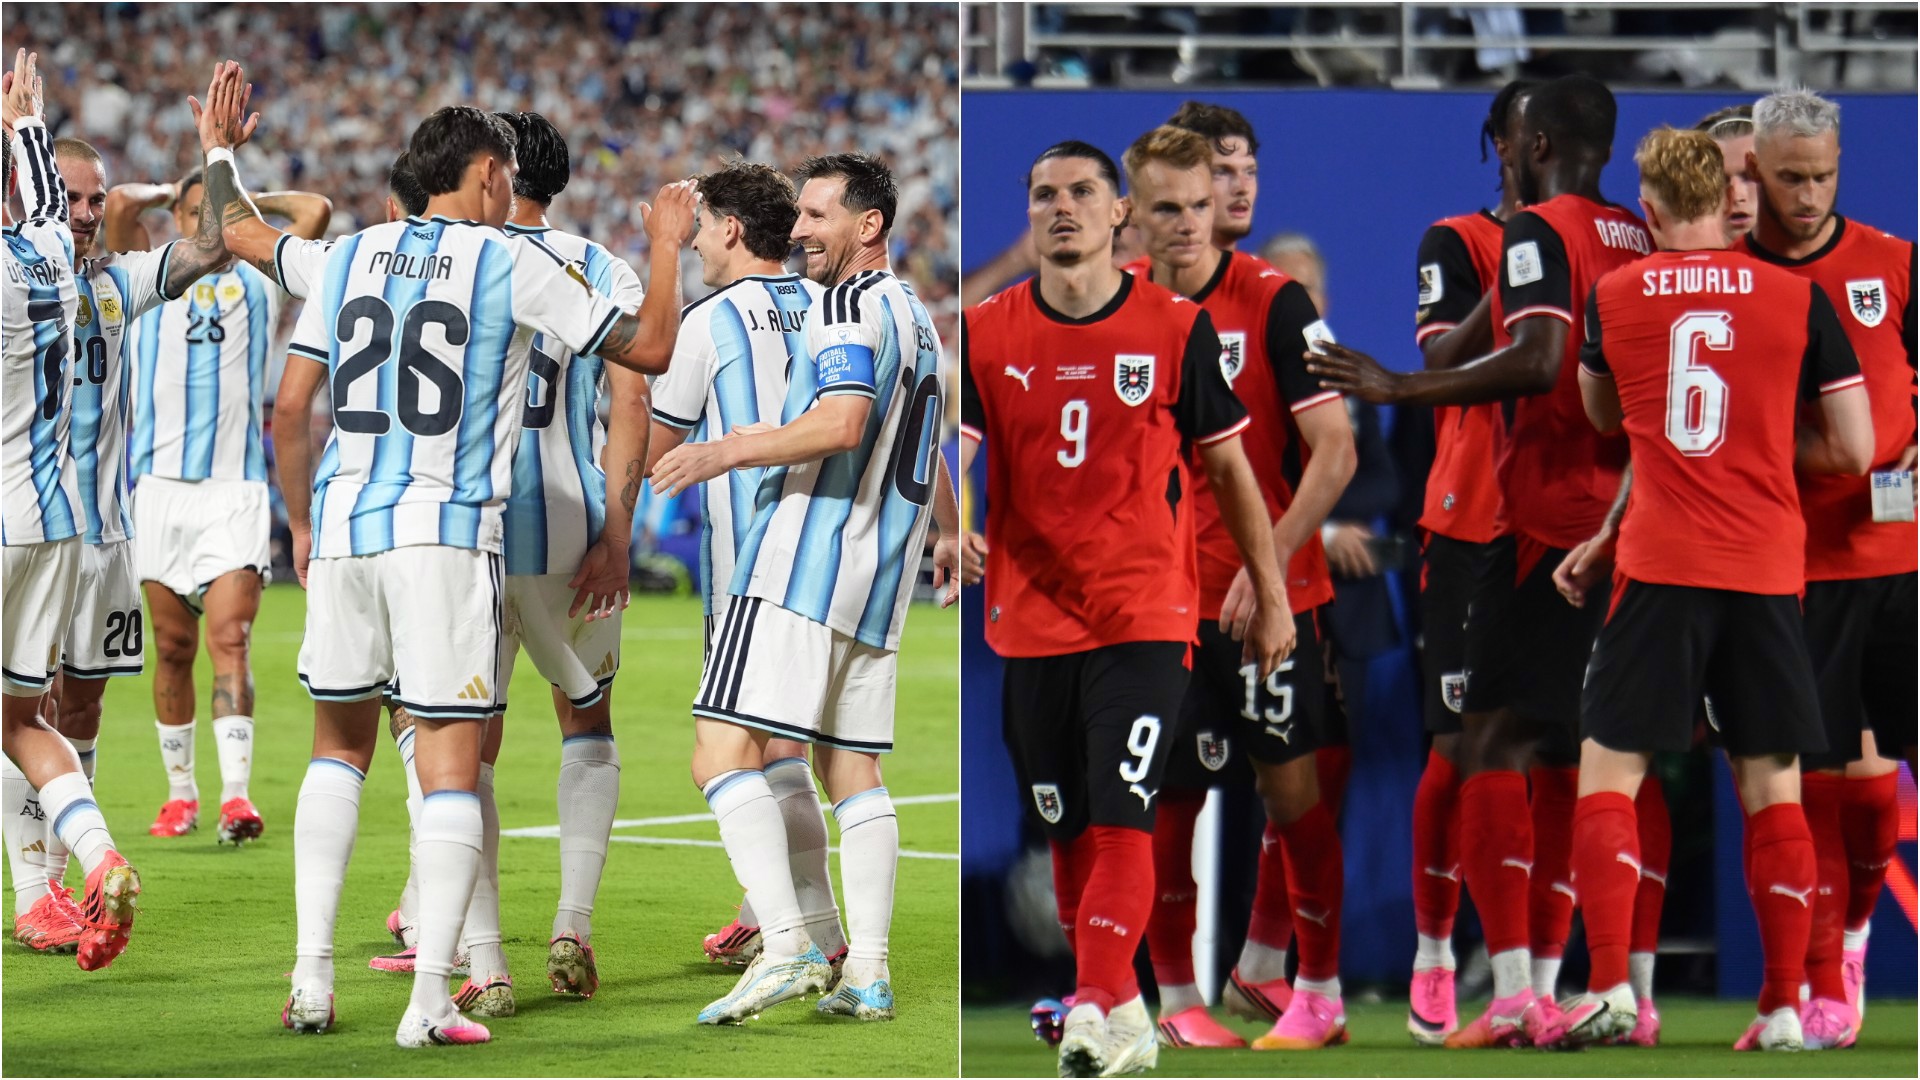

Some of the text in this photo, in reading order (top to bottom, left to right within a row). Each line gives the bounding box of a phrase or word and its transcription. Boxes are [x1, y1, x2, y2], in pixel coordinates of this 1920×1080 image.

[1594, 218, 1650, 256] DANSO
[369, 251, 453, 281] MOLINA
[1643, 267, 1753, 297] SEIWALD
[775, 285, 797, 294] 1893
[748, 309, 765, 331] J.
[333, 295, 470, 438] 26
[819, 347, 847, 363] FOOTBALL
[820, 355, 848, 372] UNITES
[828, 363, 851, 376] World
[1665, 311, 1733, 457] 6
[880, 366, 942, 506] 10
[1057, 401, 1088, 467] 9
[103, 609, 143, 658] 20
[1239, 661, 1295, 724] 15
[1119, 715, 1160, 783] 9
